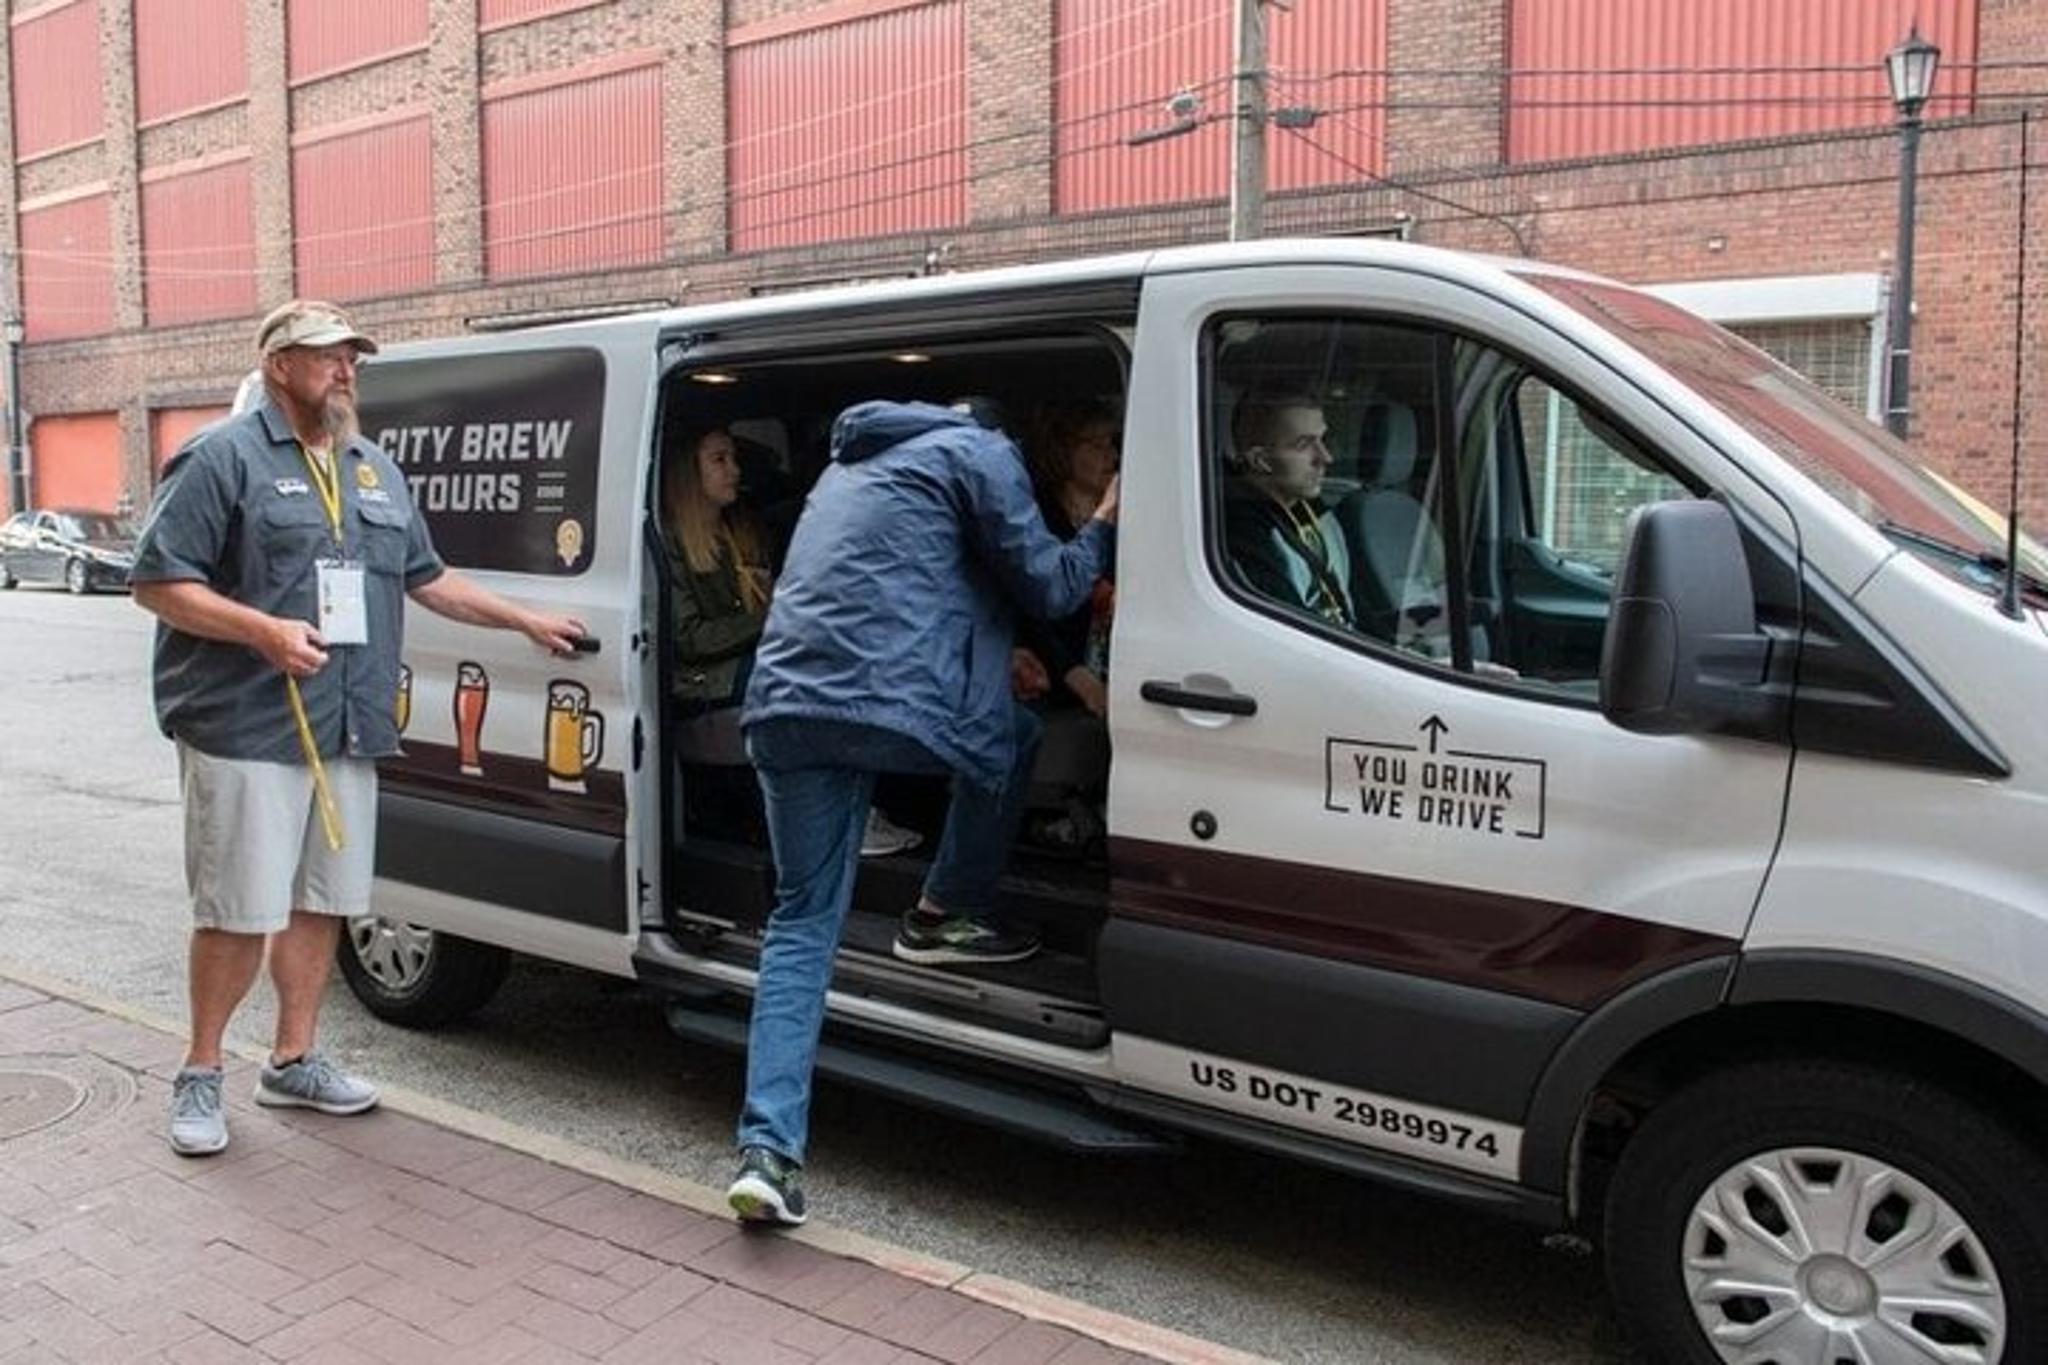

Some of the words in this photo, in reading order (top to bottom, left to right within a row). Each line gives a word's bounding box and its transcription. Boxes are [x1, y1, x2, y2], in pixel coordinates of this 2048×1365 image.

[378, 425, 454, 463] CITY
[461, 420, 572, 462] BREW
[408, 473, 521, 511] TOURS
[1354, 753, 1406, 785] YOU
[1422, 762, 1512, 799] DRINK
[1360, 786, 1404, 818] WE
[1418, 795, 1505, 833] DRIVE
[1190, 1061, 1237, 1093] US
[1249, 1076, 1321, 1113] DOT
[1334, 1096, 1499, 1158] 2989974
